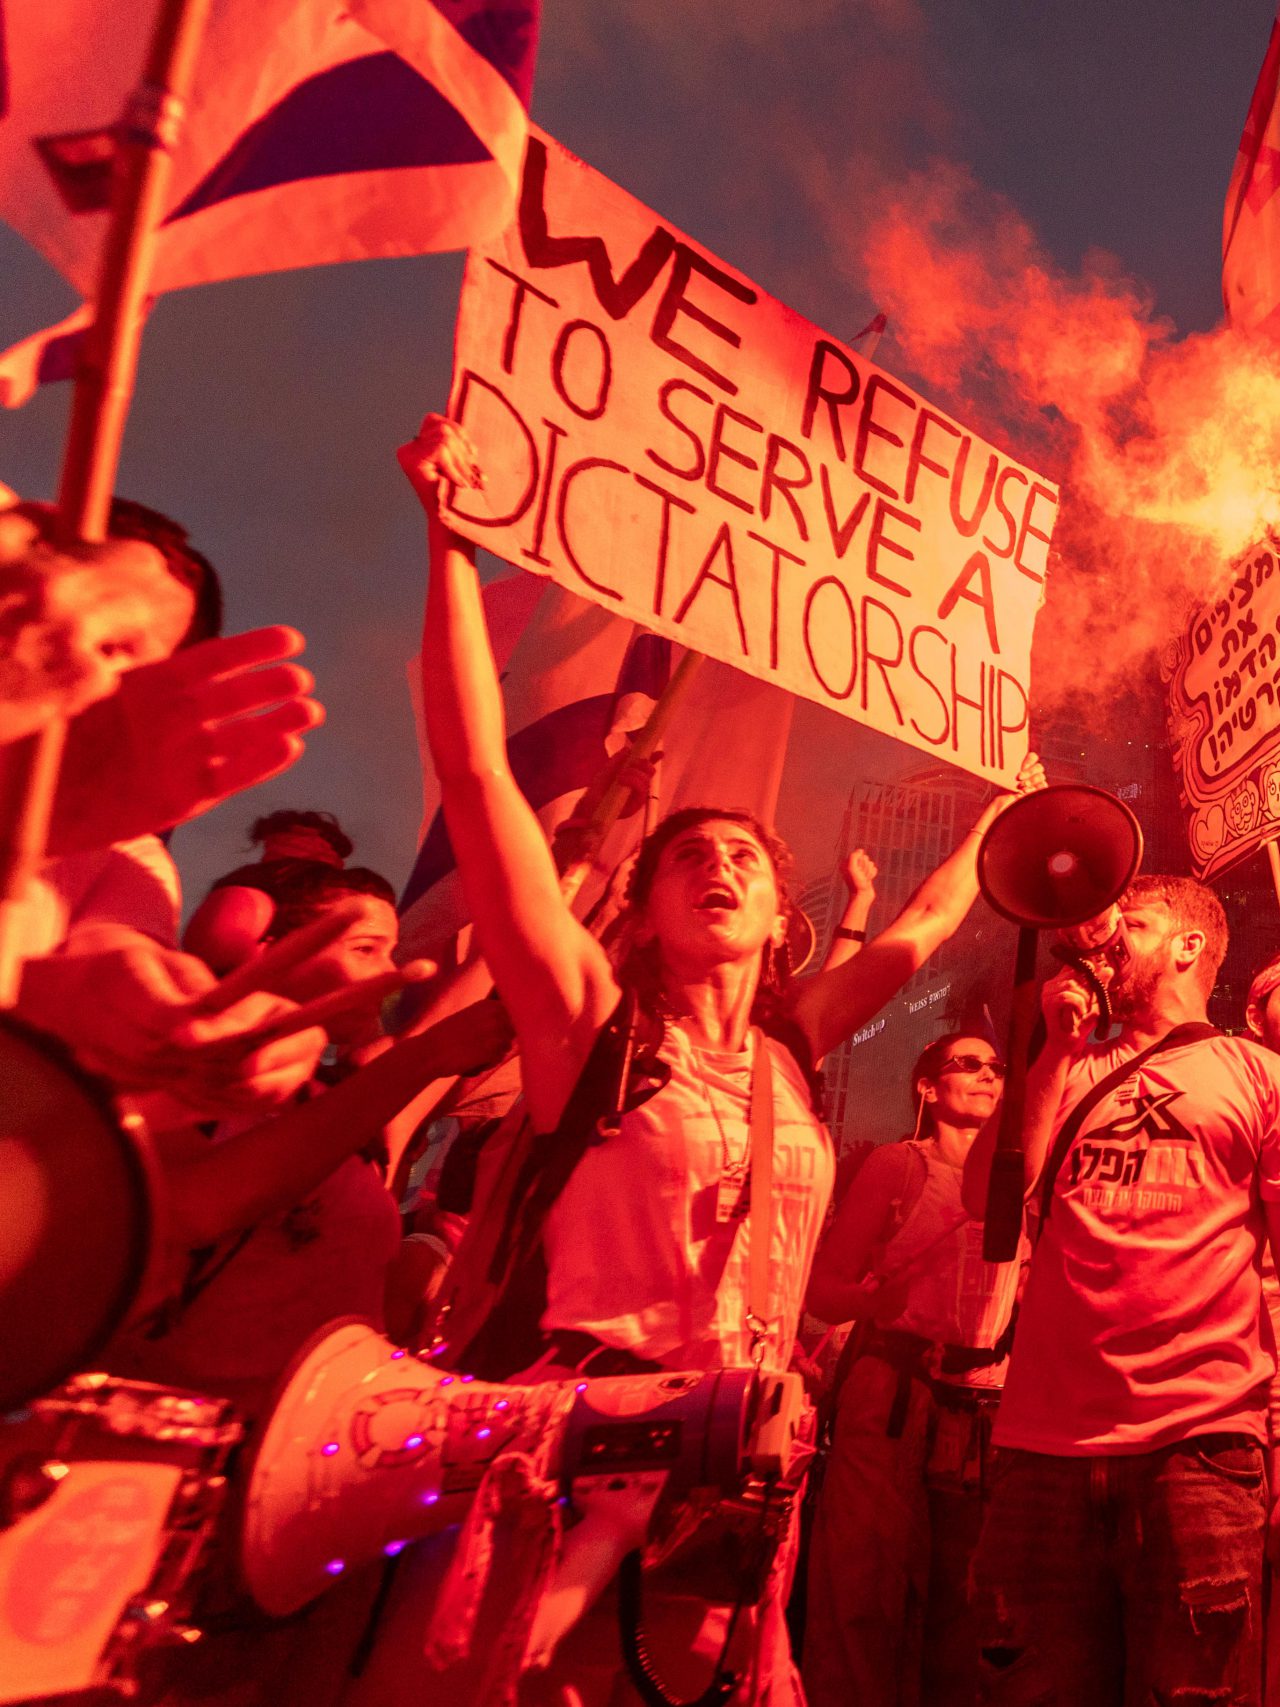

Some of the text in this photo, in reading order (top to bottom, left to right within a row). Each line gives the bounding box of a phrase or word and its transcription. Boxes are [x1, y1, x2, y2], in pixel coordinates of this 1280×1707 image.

[486, 256, 1001, 654] TO SERVE A
[515, 134, 1059, 586] WE REFUSE
[446, 368, 1029, 770] DICTATORSHIP
[1218, 608, 1258, 668] את
